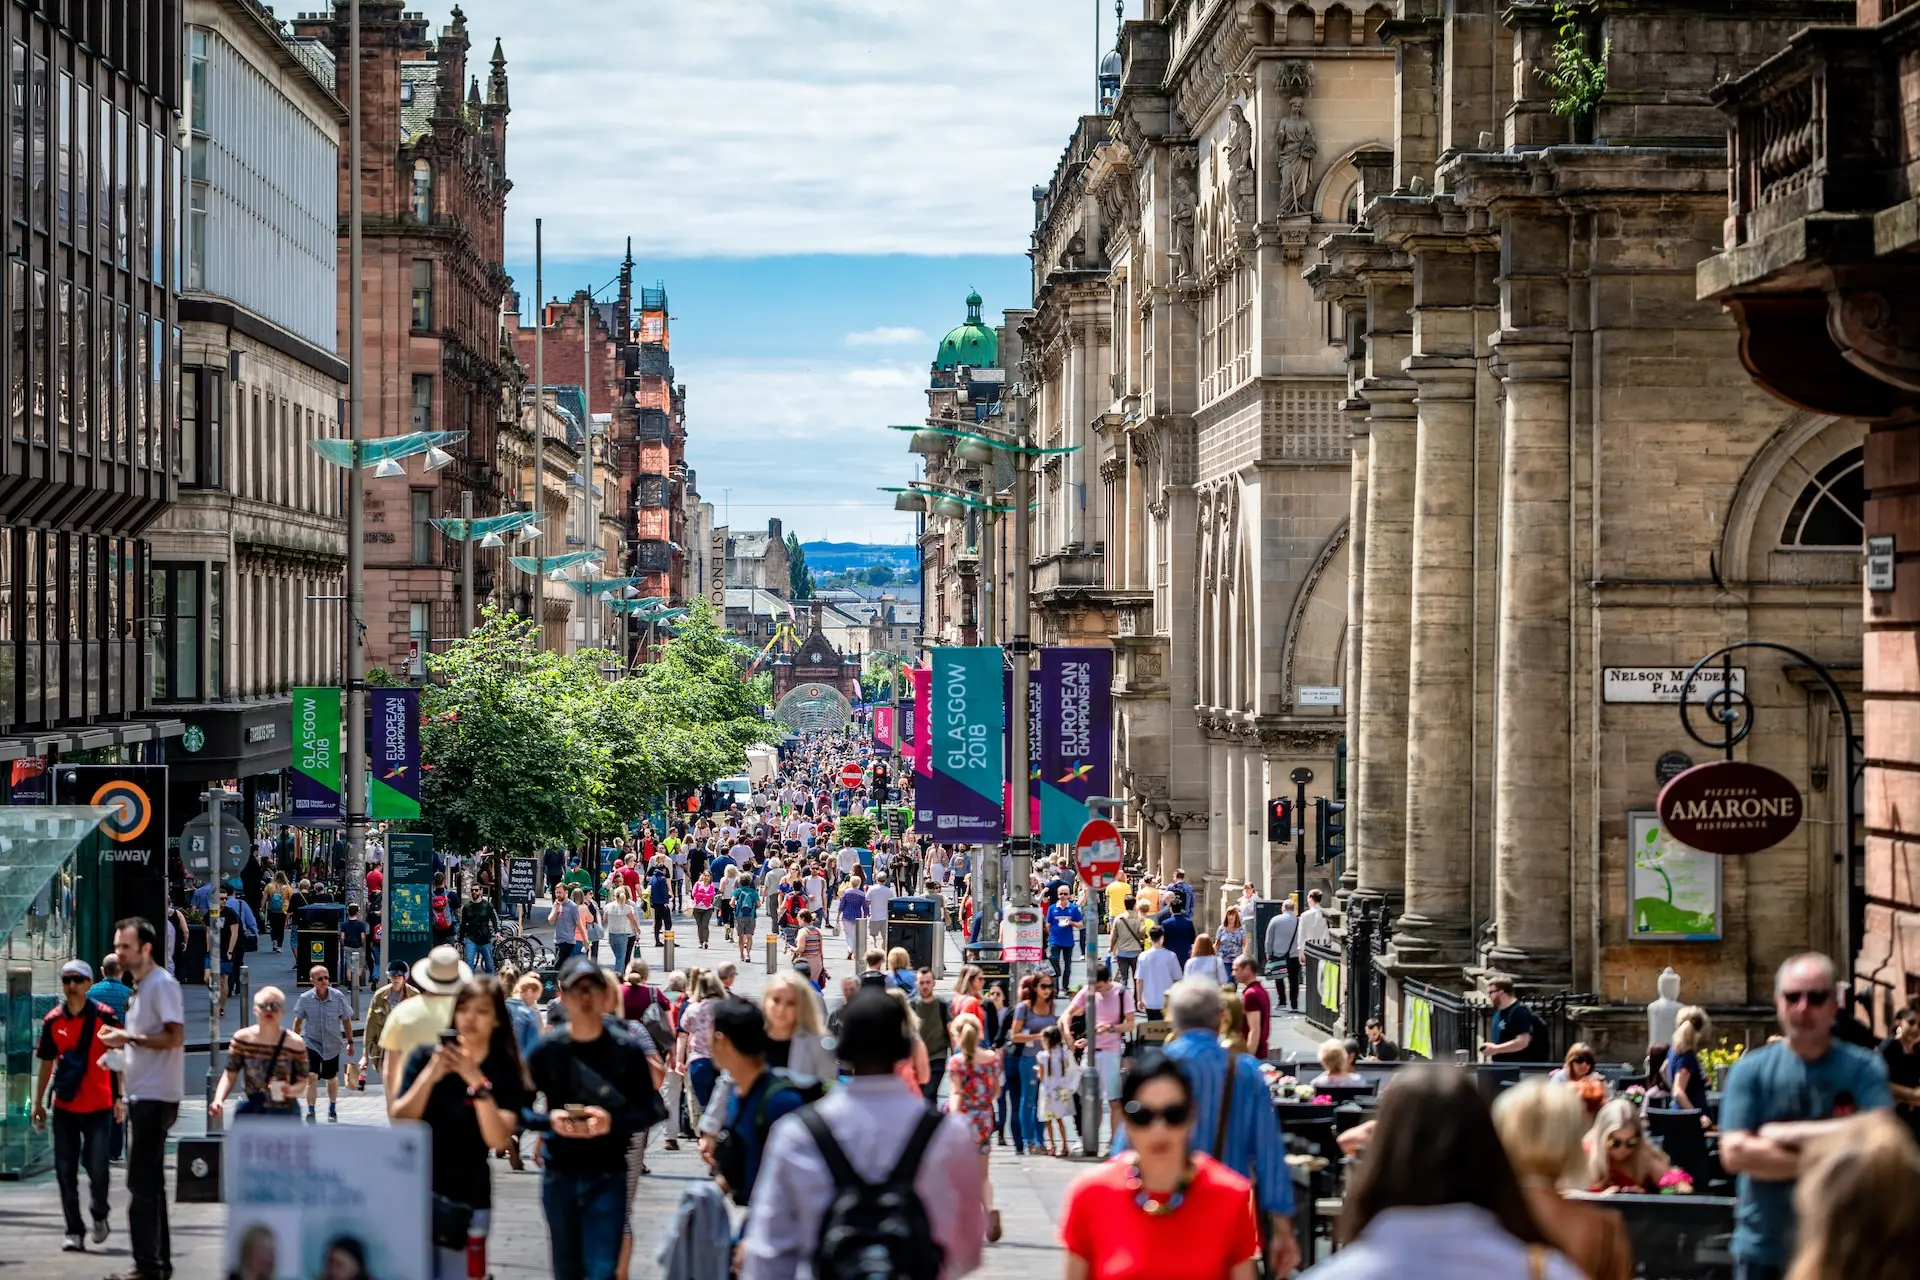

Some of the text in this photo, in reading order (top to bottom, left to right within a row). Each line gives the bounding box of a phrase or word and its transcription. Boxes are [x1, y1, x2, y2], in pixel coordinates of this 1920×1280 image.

[712, 536, 724, 552] ST
[1611, 670, 1664, 681] NELSON
[948, 663, 966, 768] GLASGOW
[1061, 662, 1078, 756] EUROPEAN
[1078, 662, 1090, 756] CHAMPIONSHIPS
[303, 698, 316, 768] GLASGOW
[386, 698, 398, 760] EUROPEAN
[968, 724, 986, 768] 2018
[317, 738, 330, 768] 2018
[1670, 798, 1794, 820] AMARONE
[1704, 788, 1758, 796] PIZZERIA
[1696, 821, 1768, 830] RISTORANTE
